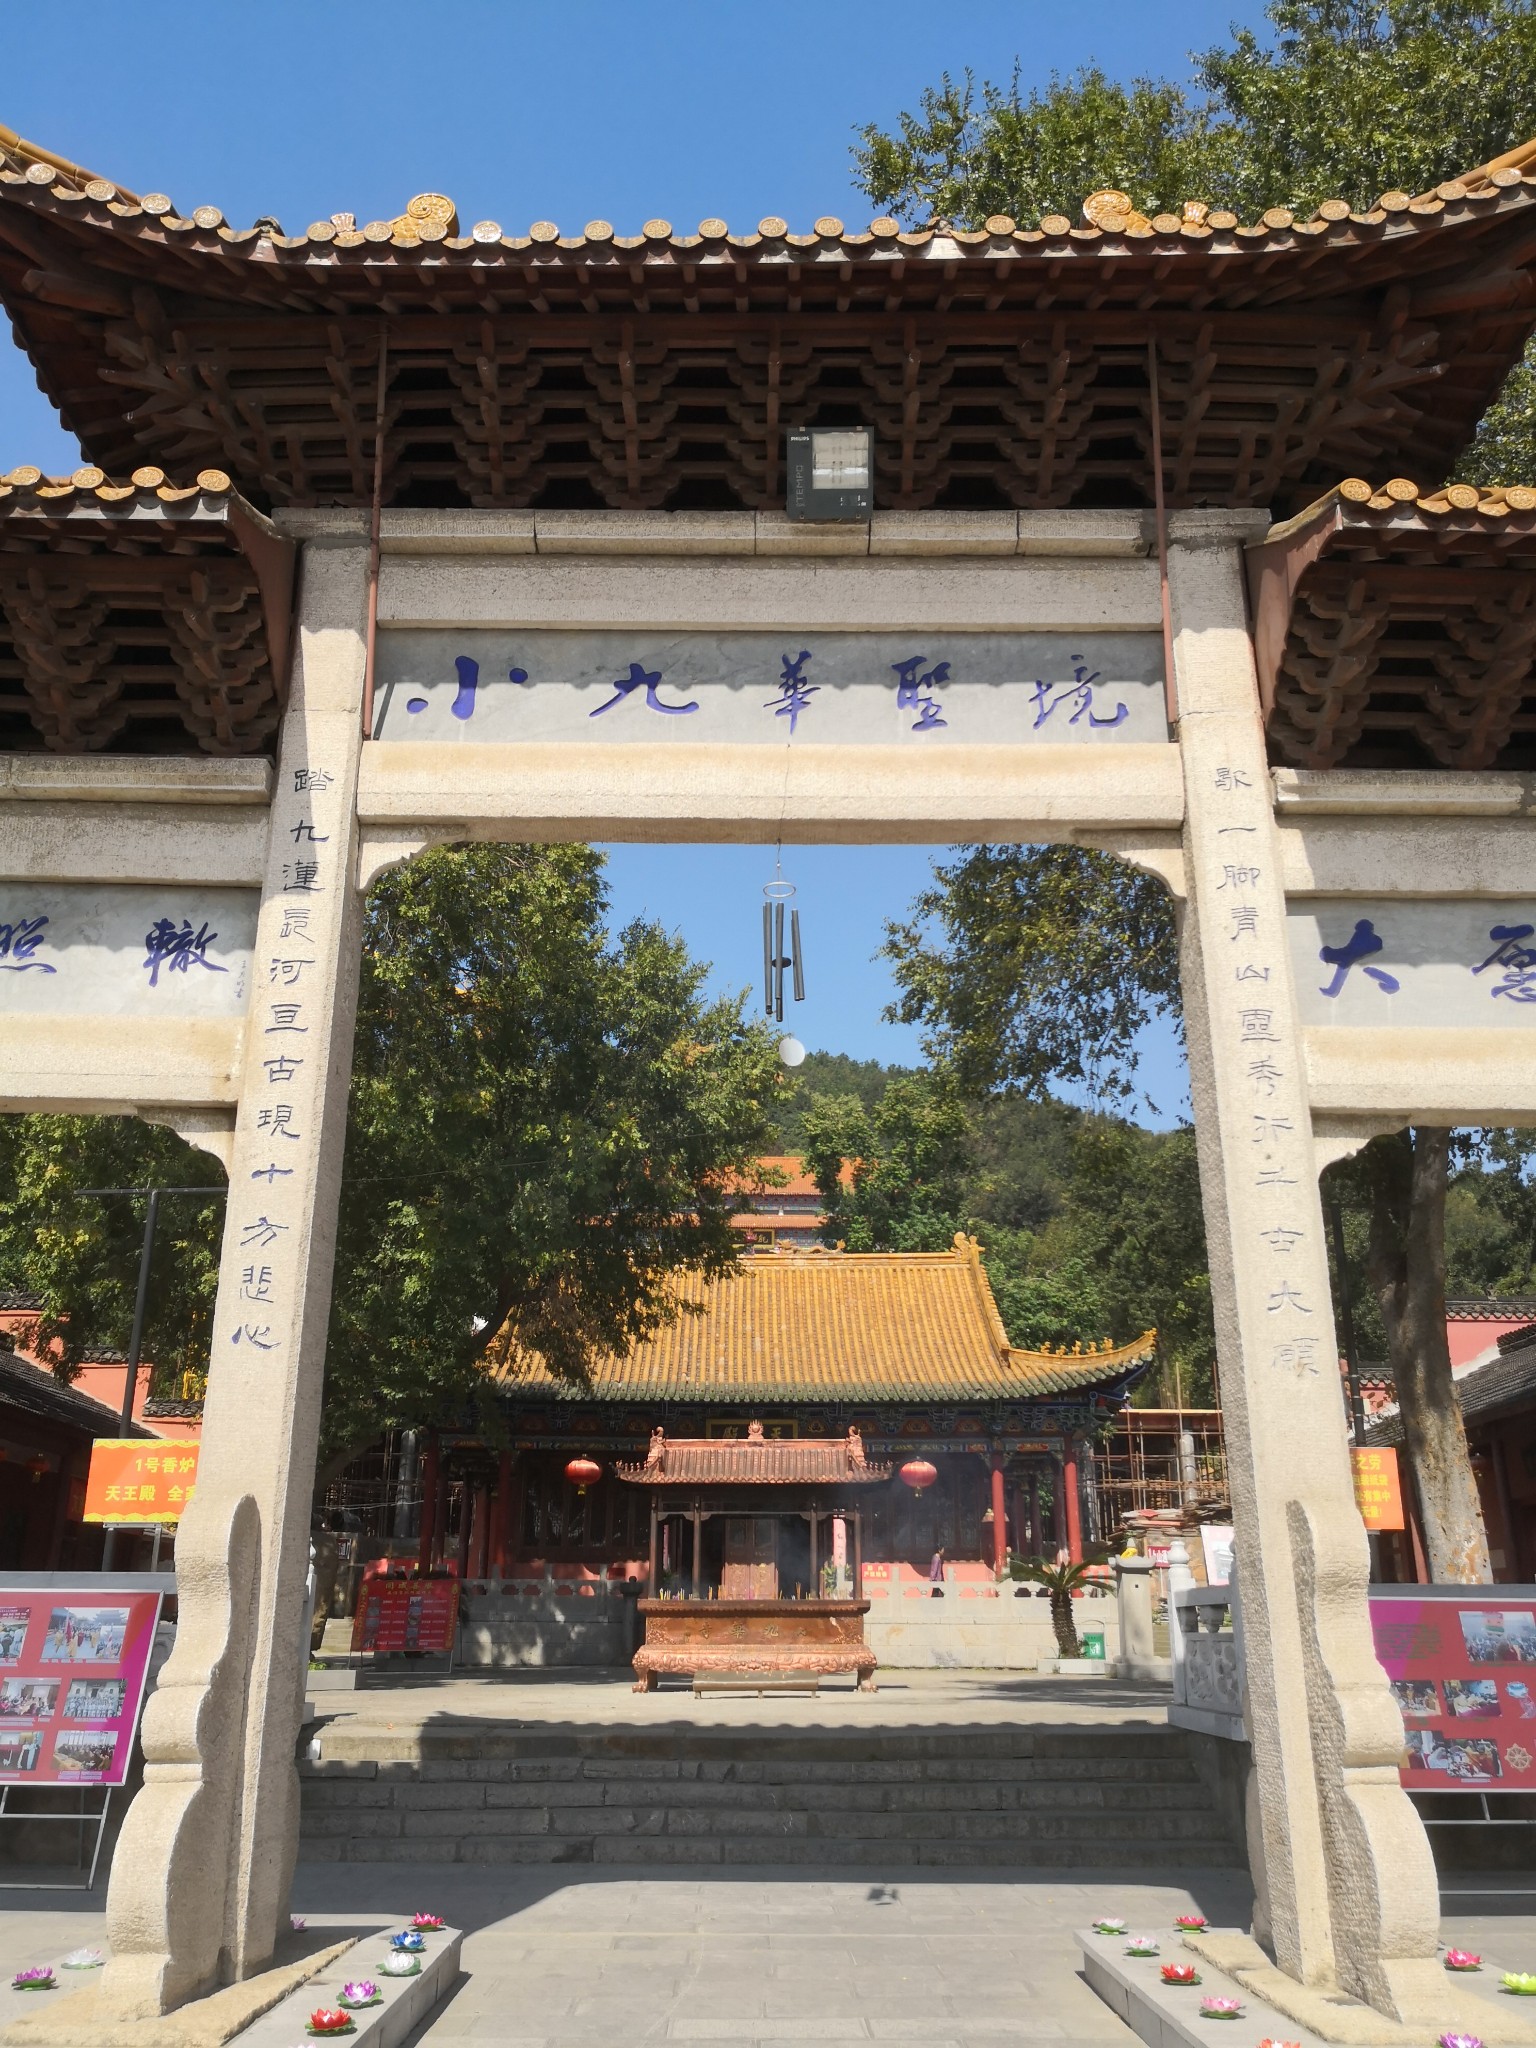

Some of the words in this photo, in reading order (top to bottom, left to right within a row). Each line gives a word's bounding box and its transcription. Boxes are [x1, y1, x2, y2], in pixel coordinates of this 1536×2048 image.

[135, 1456, 196, 1473] 1号香炉
[1350, 1453, 1381, 1470] 之劳
[105, 1485, 156, 1501] 天王殿
